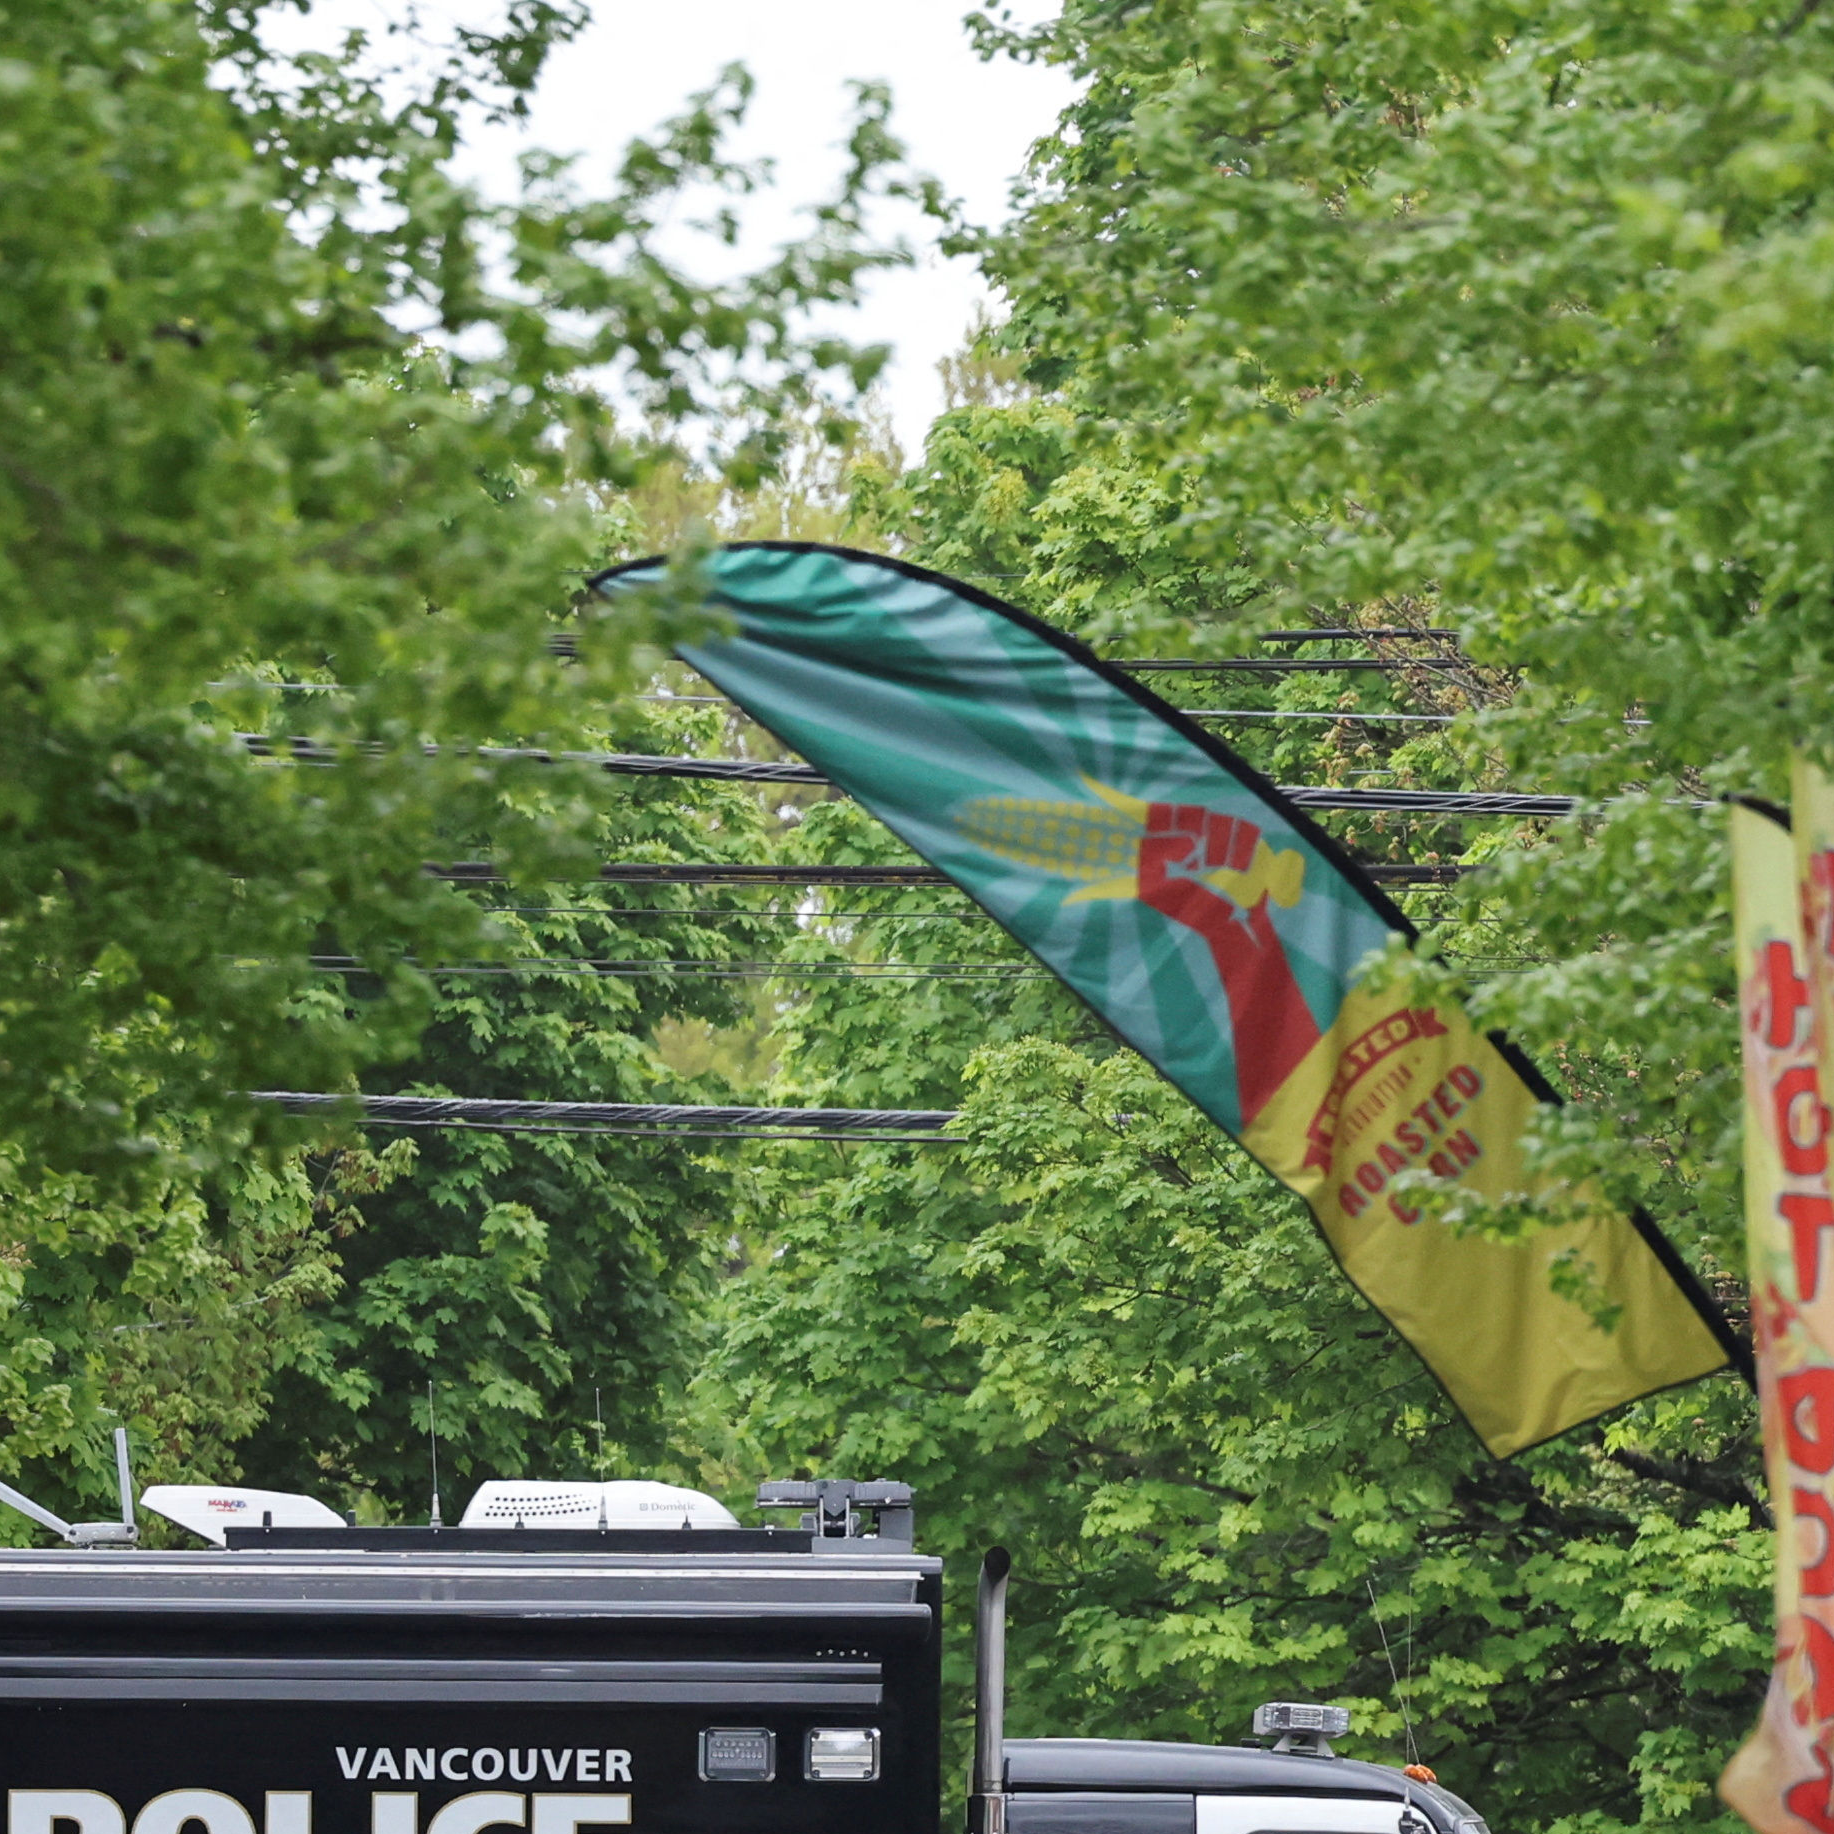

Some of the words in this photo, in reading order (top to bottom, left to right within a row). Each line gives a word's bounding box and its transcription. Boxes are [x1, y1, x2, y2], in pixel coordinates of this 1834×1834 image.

[1338, 1064, 1483, 1220] ROASTED
[1387, 1129, 1483, 1228] CRN
[335, 1747, 633, 1782] VANCOUVER
